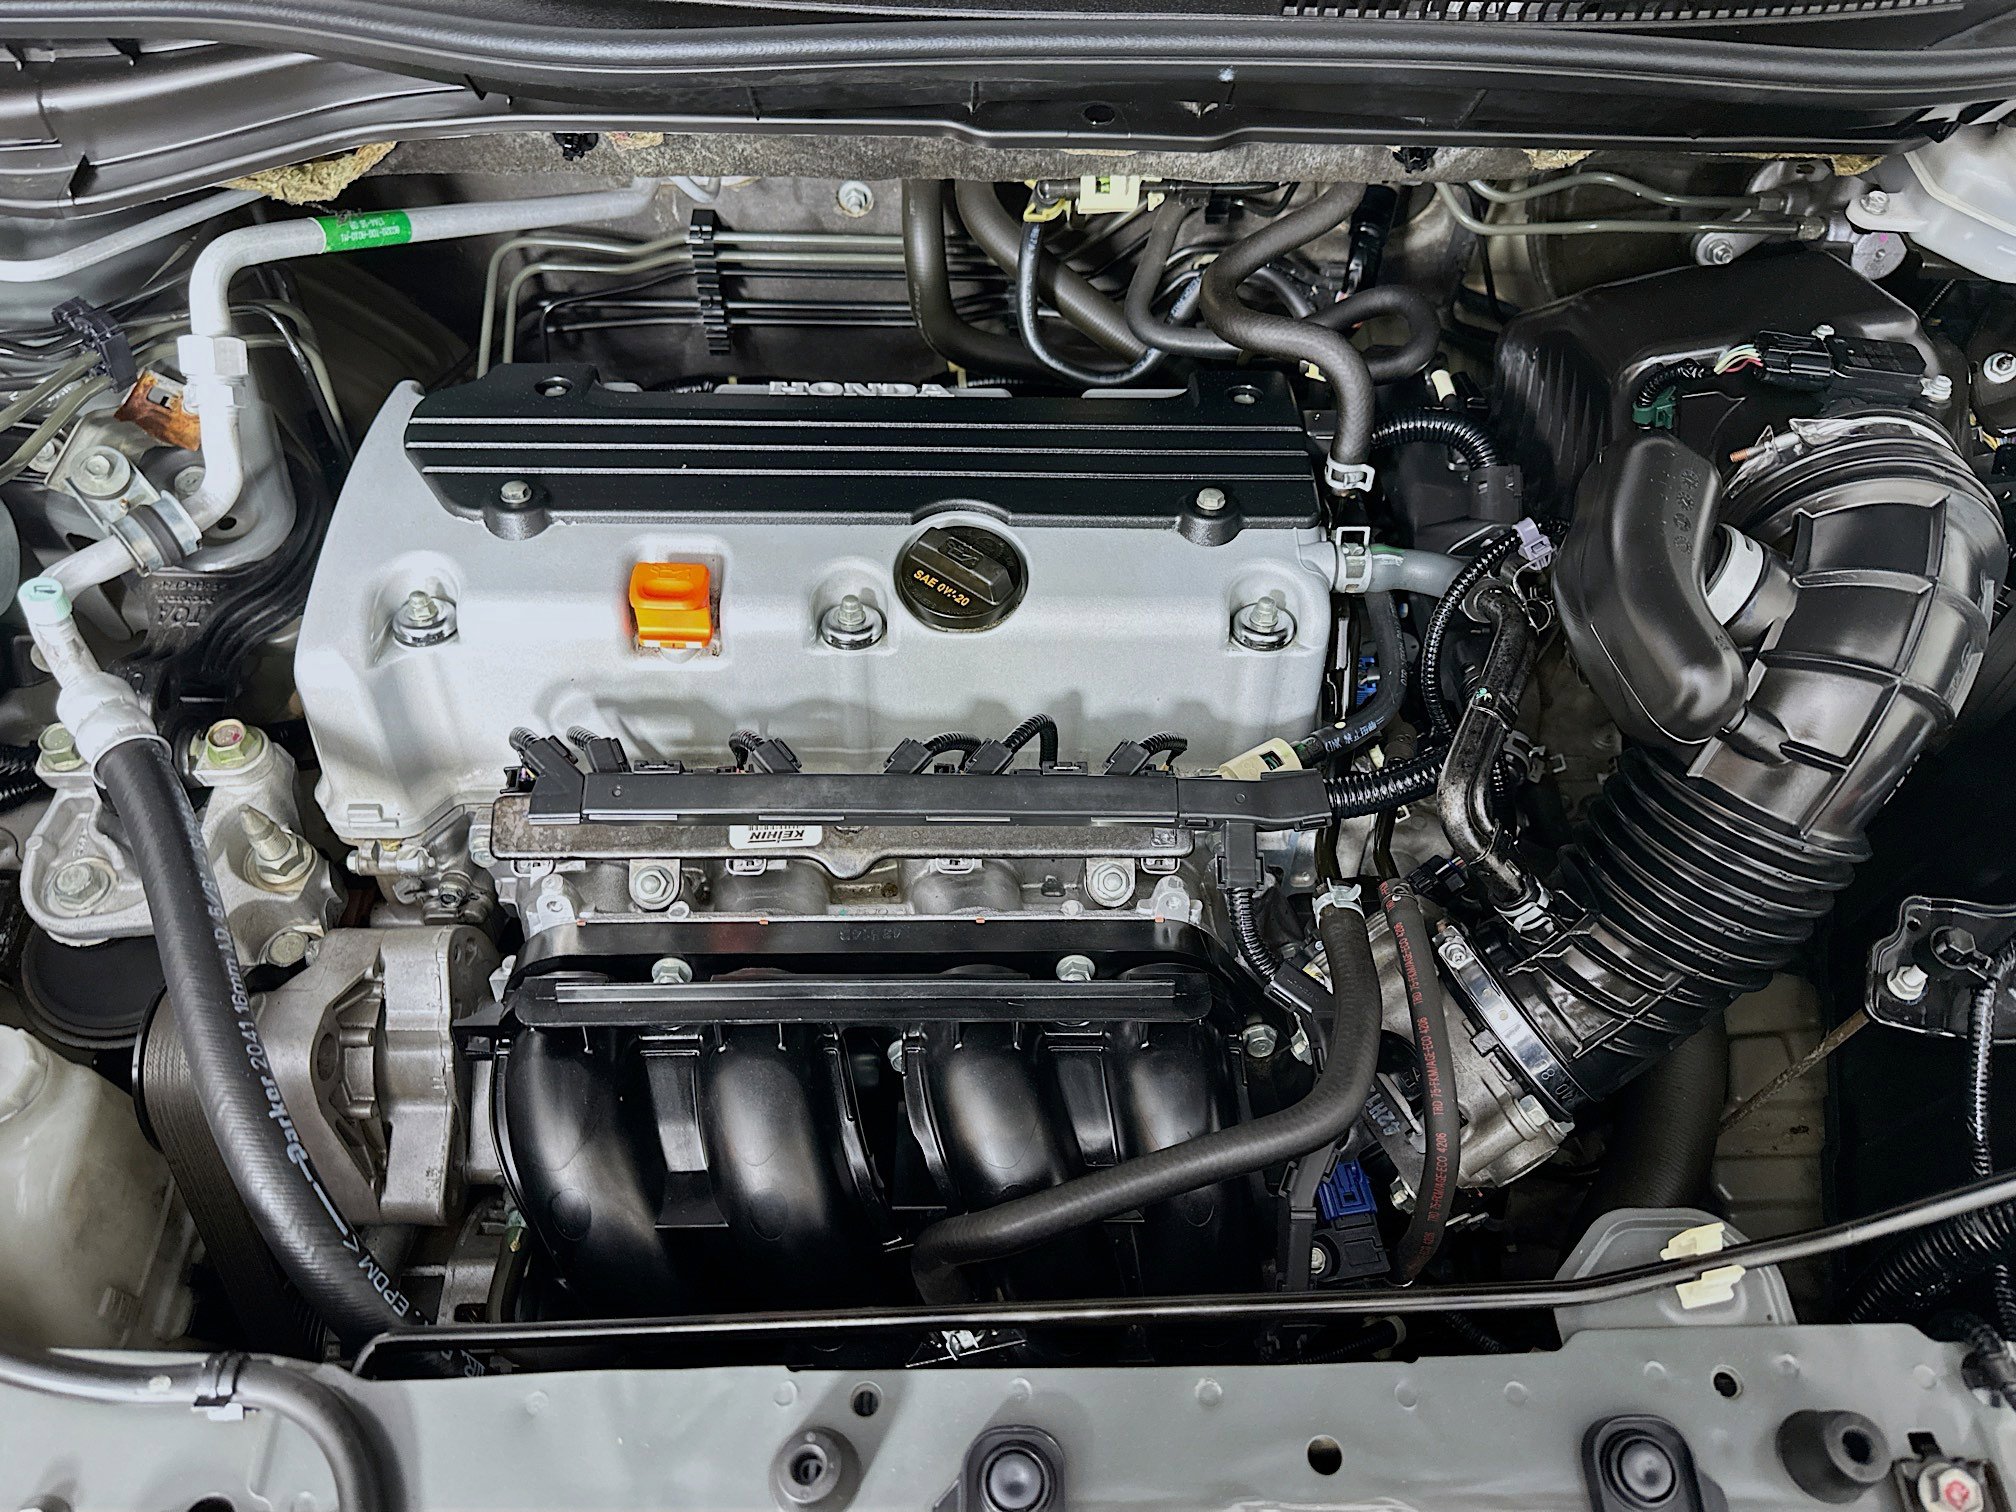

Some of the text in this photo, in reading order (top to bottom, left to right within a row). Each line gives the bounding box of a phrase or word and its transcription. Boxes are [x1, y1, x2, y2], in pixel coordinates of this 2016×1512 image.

[768, 381, 955, 398] HONDA
[913, 569, 939, 588] SAE
[936, 583, 970, 607] 0W-20
[226, 958, 249, 1013] 16mm
[238, 1020, 267, 1070] 2041
[1431, 1100, 1445, 1116] TRD
[1435, 1132, 1448, 1153] 4206
[358, 1255, 410, 1318] EPDM
